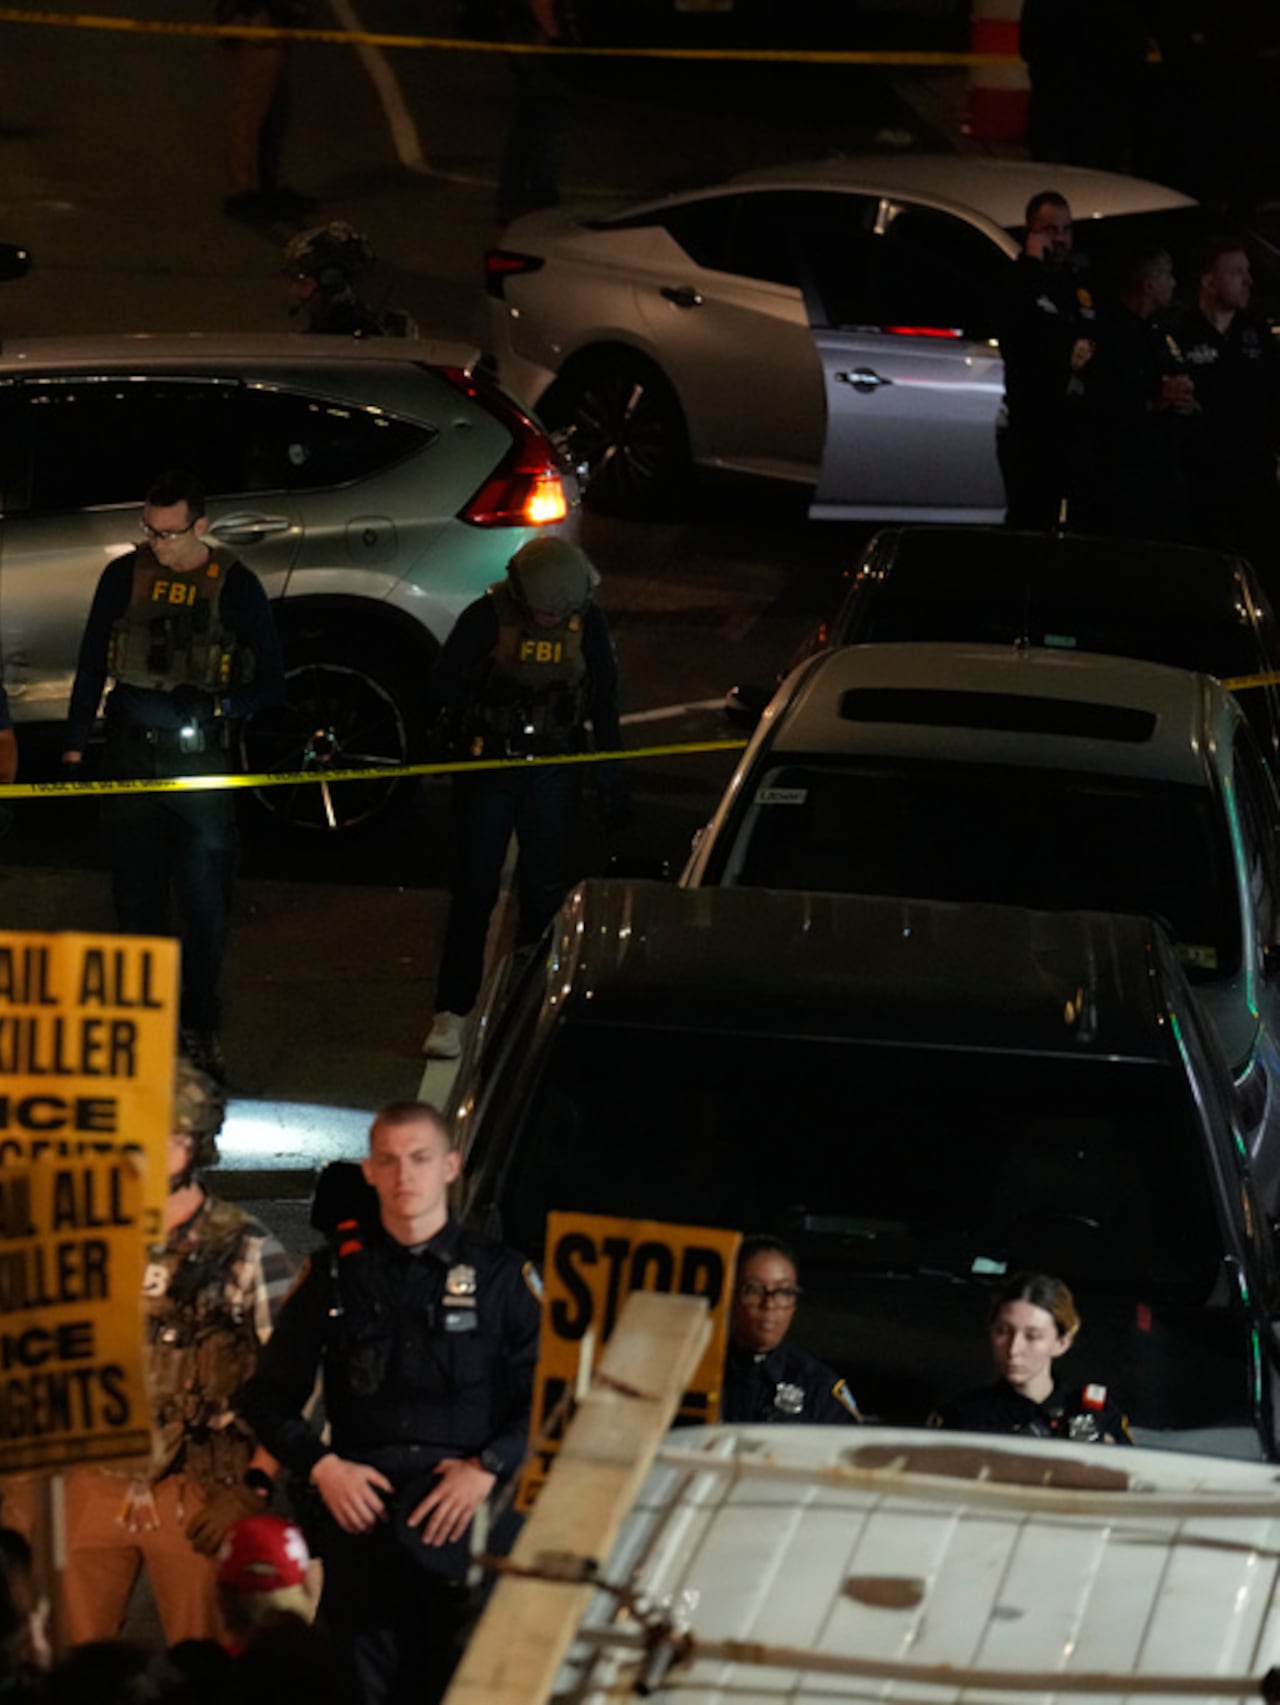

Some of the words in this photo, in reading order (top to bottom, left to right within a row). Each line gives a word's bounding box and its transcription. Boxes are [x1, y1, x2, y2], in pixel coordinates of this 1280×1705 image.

[152, 580, 196, 607] FBI
[521, 641, 562, 664] FBI
[78, 948, 163, 1010] ALL
[53, 1165, 133, 1232] ALL
